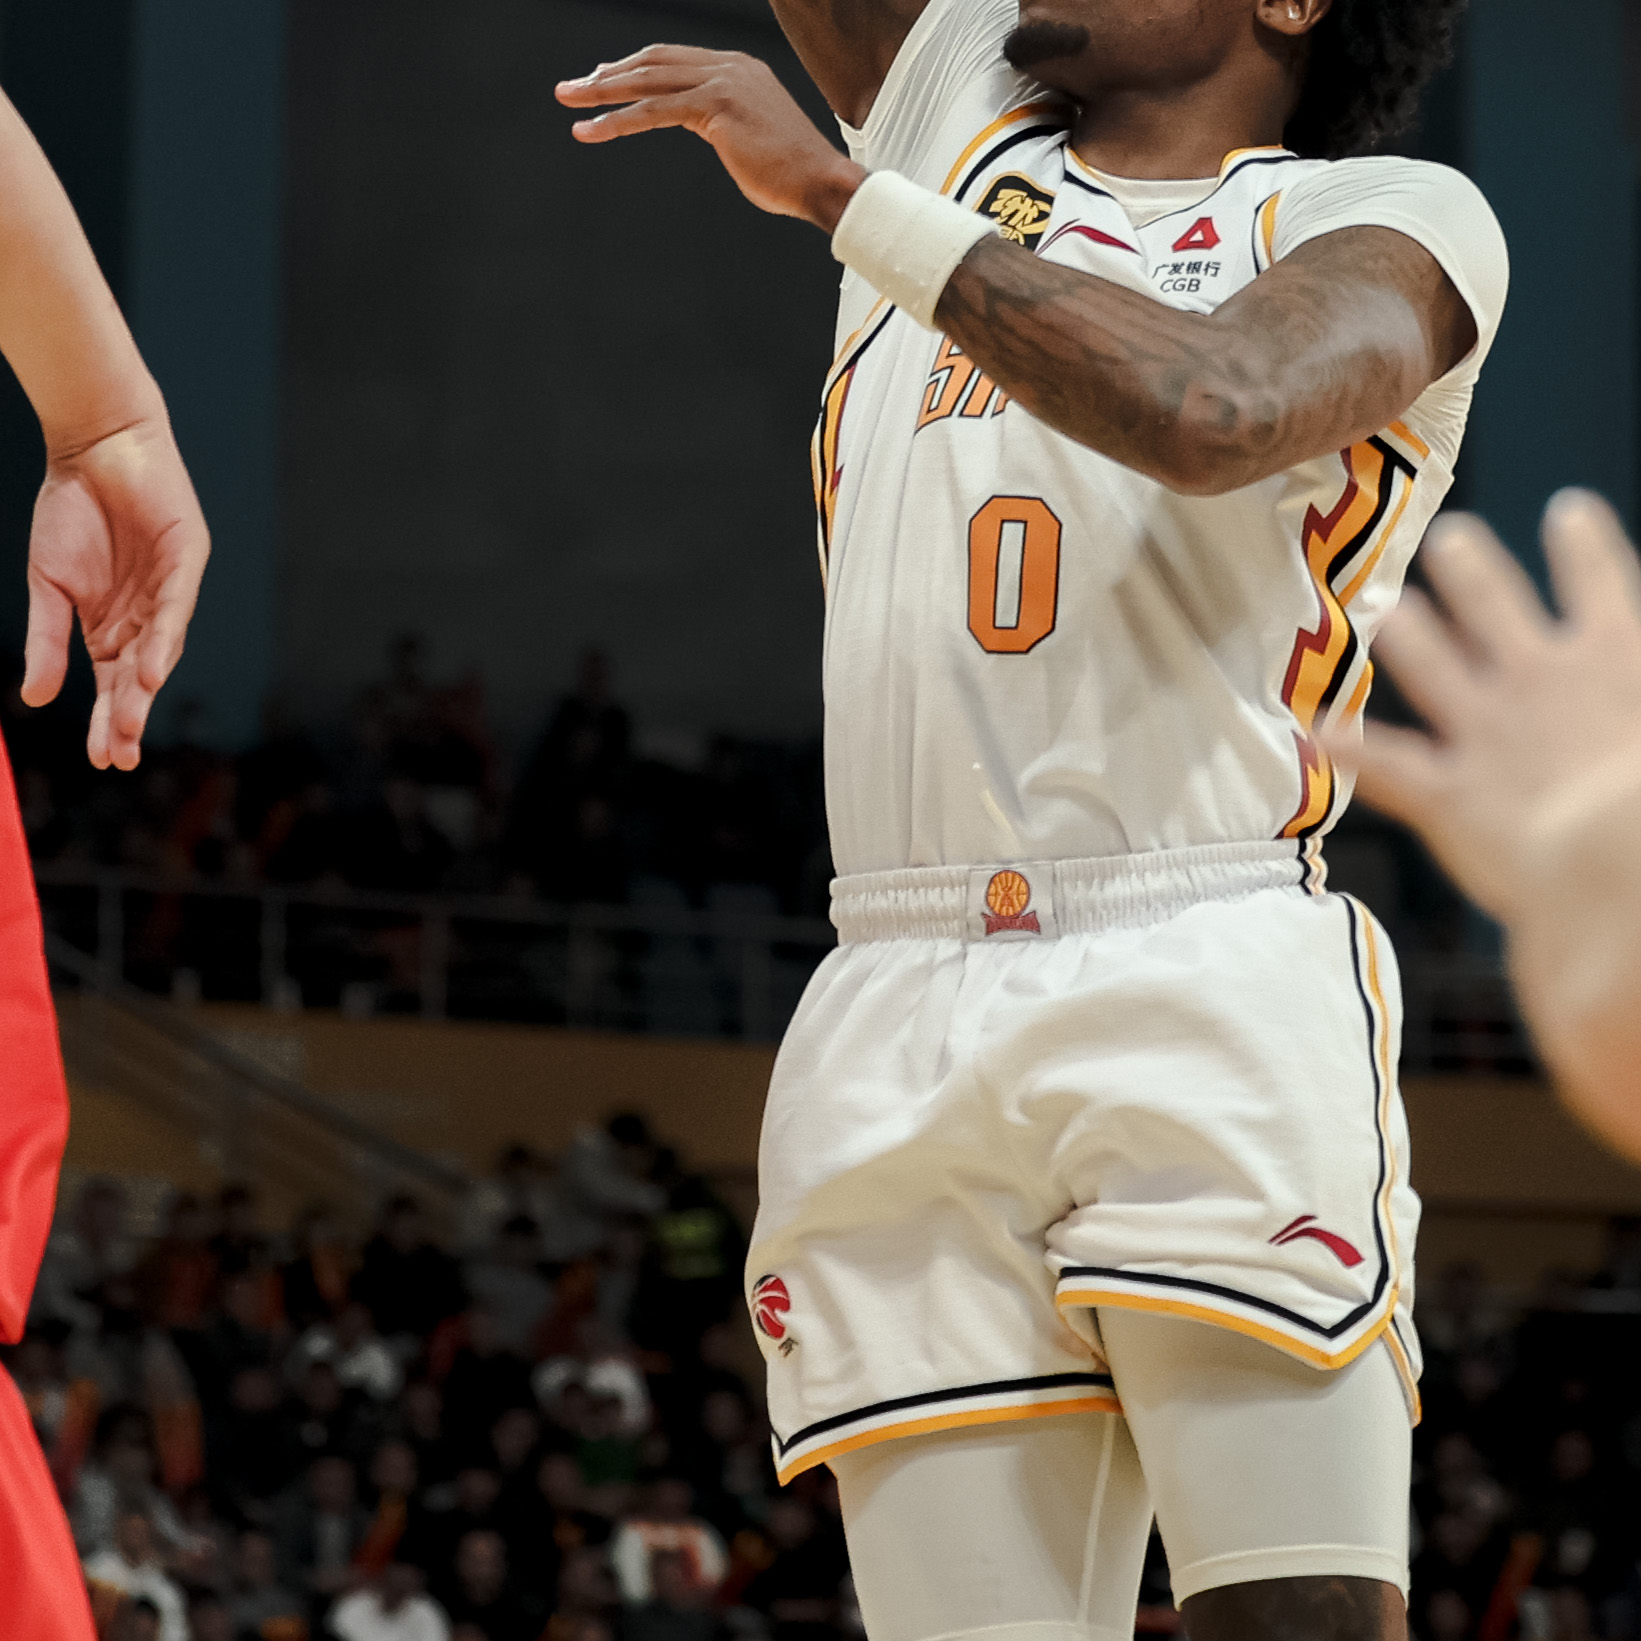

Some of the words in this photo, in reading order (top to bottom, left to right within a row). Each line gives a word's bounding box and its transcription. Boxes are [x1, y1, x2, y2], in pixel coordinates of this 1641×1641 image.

[1151, 261, 1222, 279] 广发银行
[1160, 278, 1201, 293] CGB
[967, 494, 1062, 654] 0
